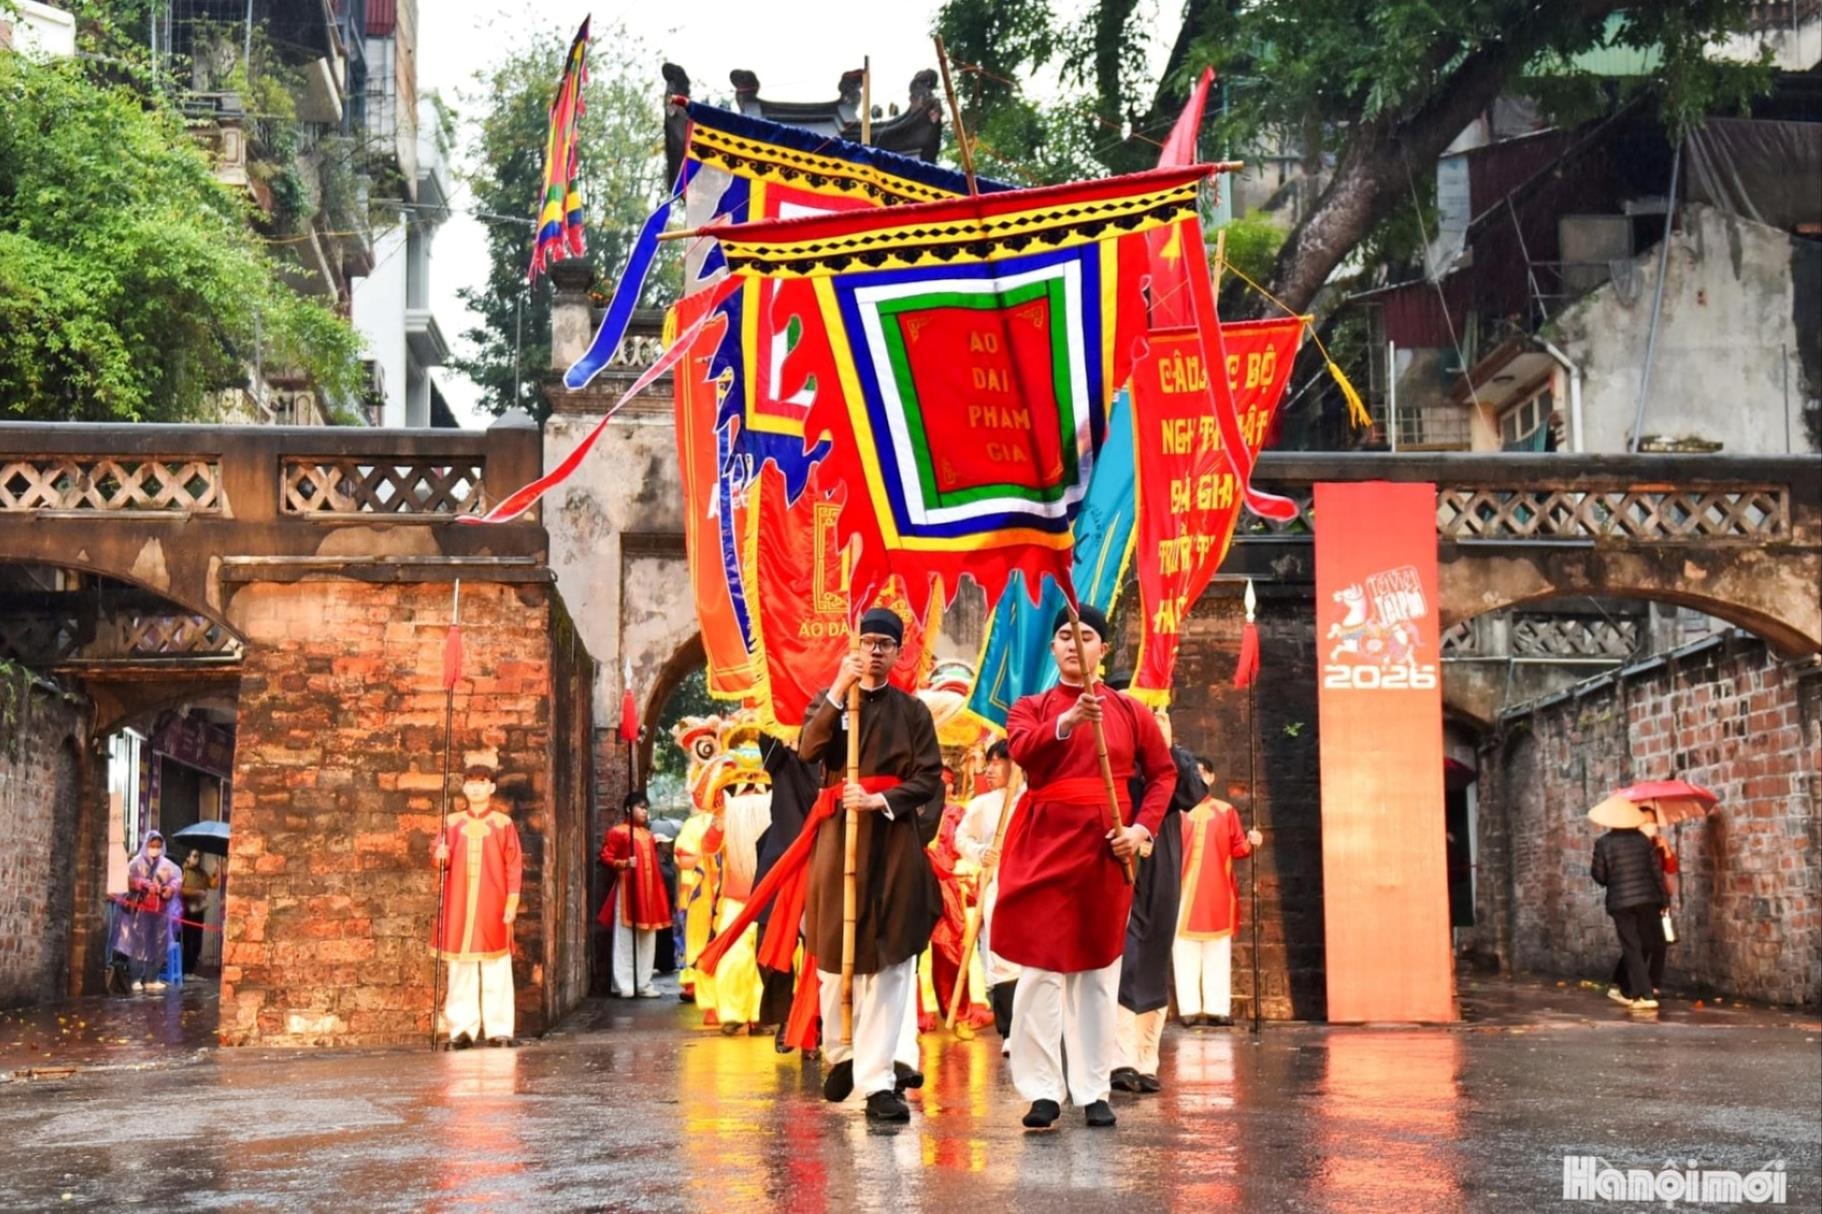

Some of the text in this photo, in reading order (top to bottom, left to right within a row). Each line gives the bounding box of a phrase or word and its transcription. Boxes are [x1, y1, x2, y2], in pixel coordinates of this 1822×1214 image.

[1158, 349, 1199, 394] CÂU
[1244, 343, 1277, 394] BỘ
[986, 442, 1027, 462] GIA
[1324, 664, 1436, 689] 2026
